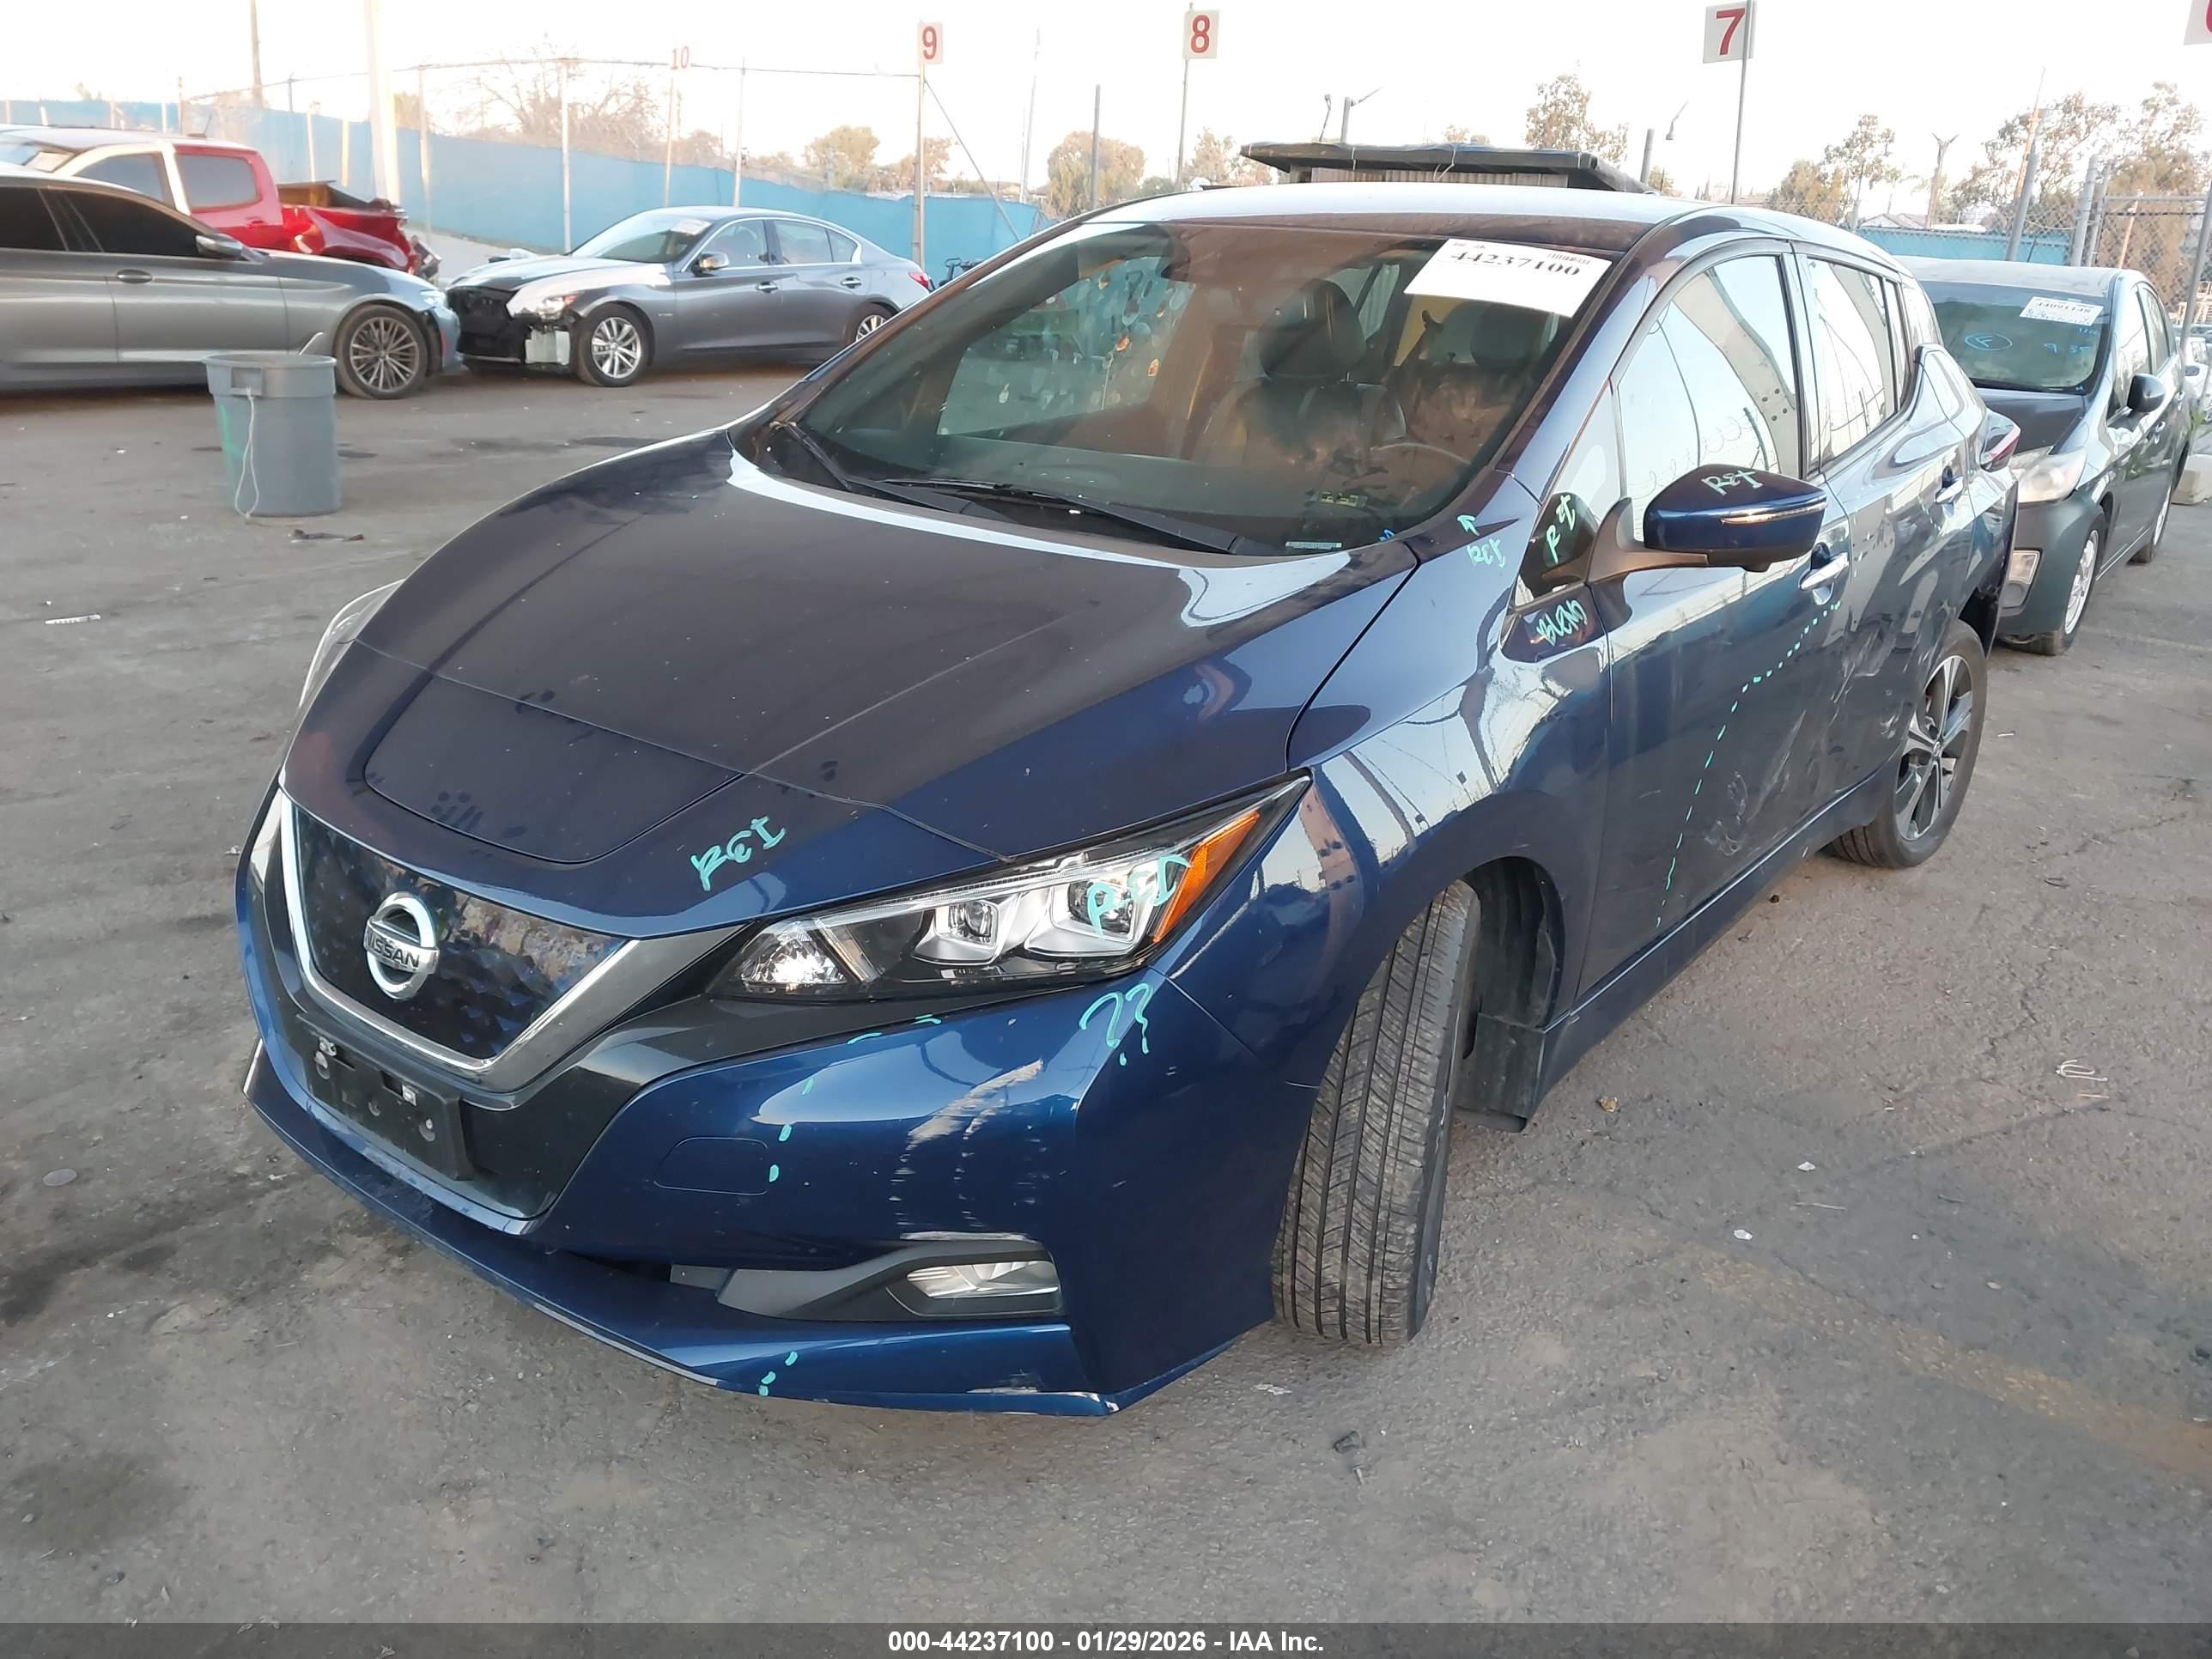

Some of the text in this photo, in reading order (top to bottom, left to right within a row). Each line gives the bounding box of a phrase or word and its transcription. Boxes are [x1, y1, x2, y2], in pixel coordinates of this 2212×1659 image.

[921, 26, 937, 59] 9
[1190, 15, 1210, 53] 8
[1716, 8, 1746, 56] 7
[671, 46, 690, 70] 10
[1449, 251, 1581, 276] 44237100
[367, 932, 421, 969] NISSAN
